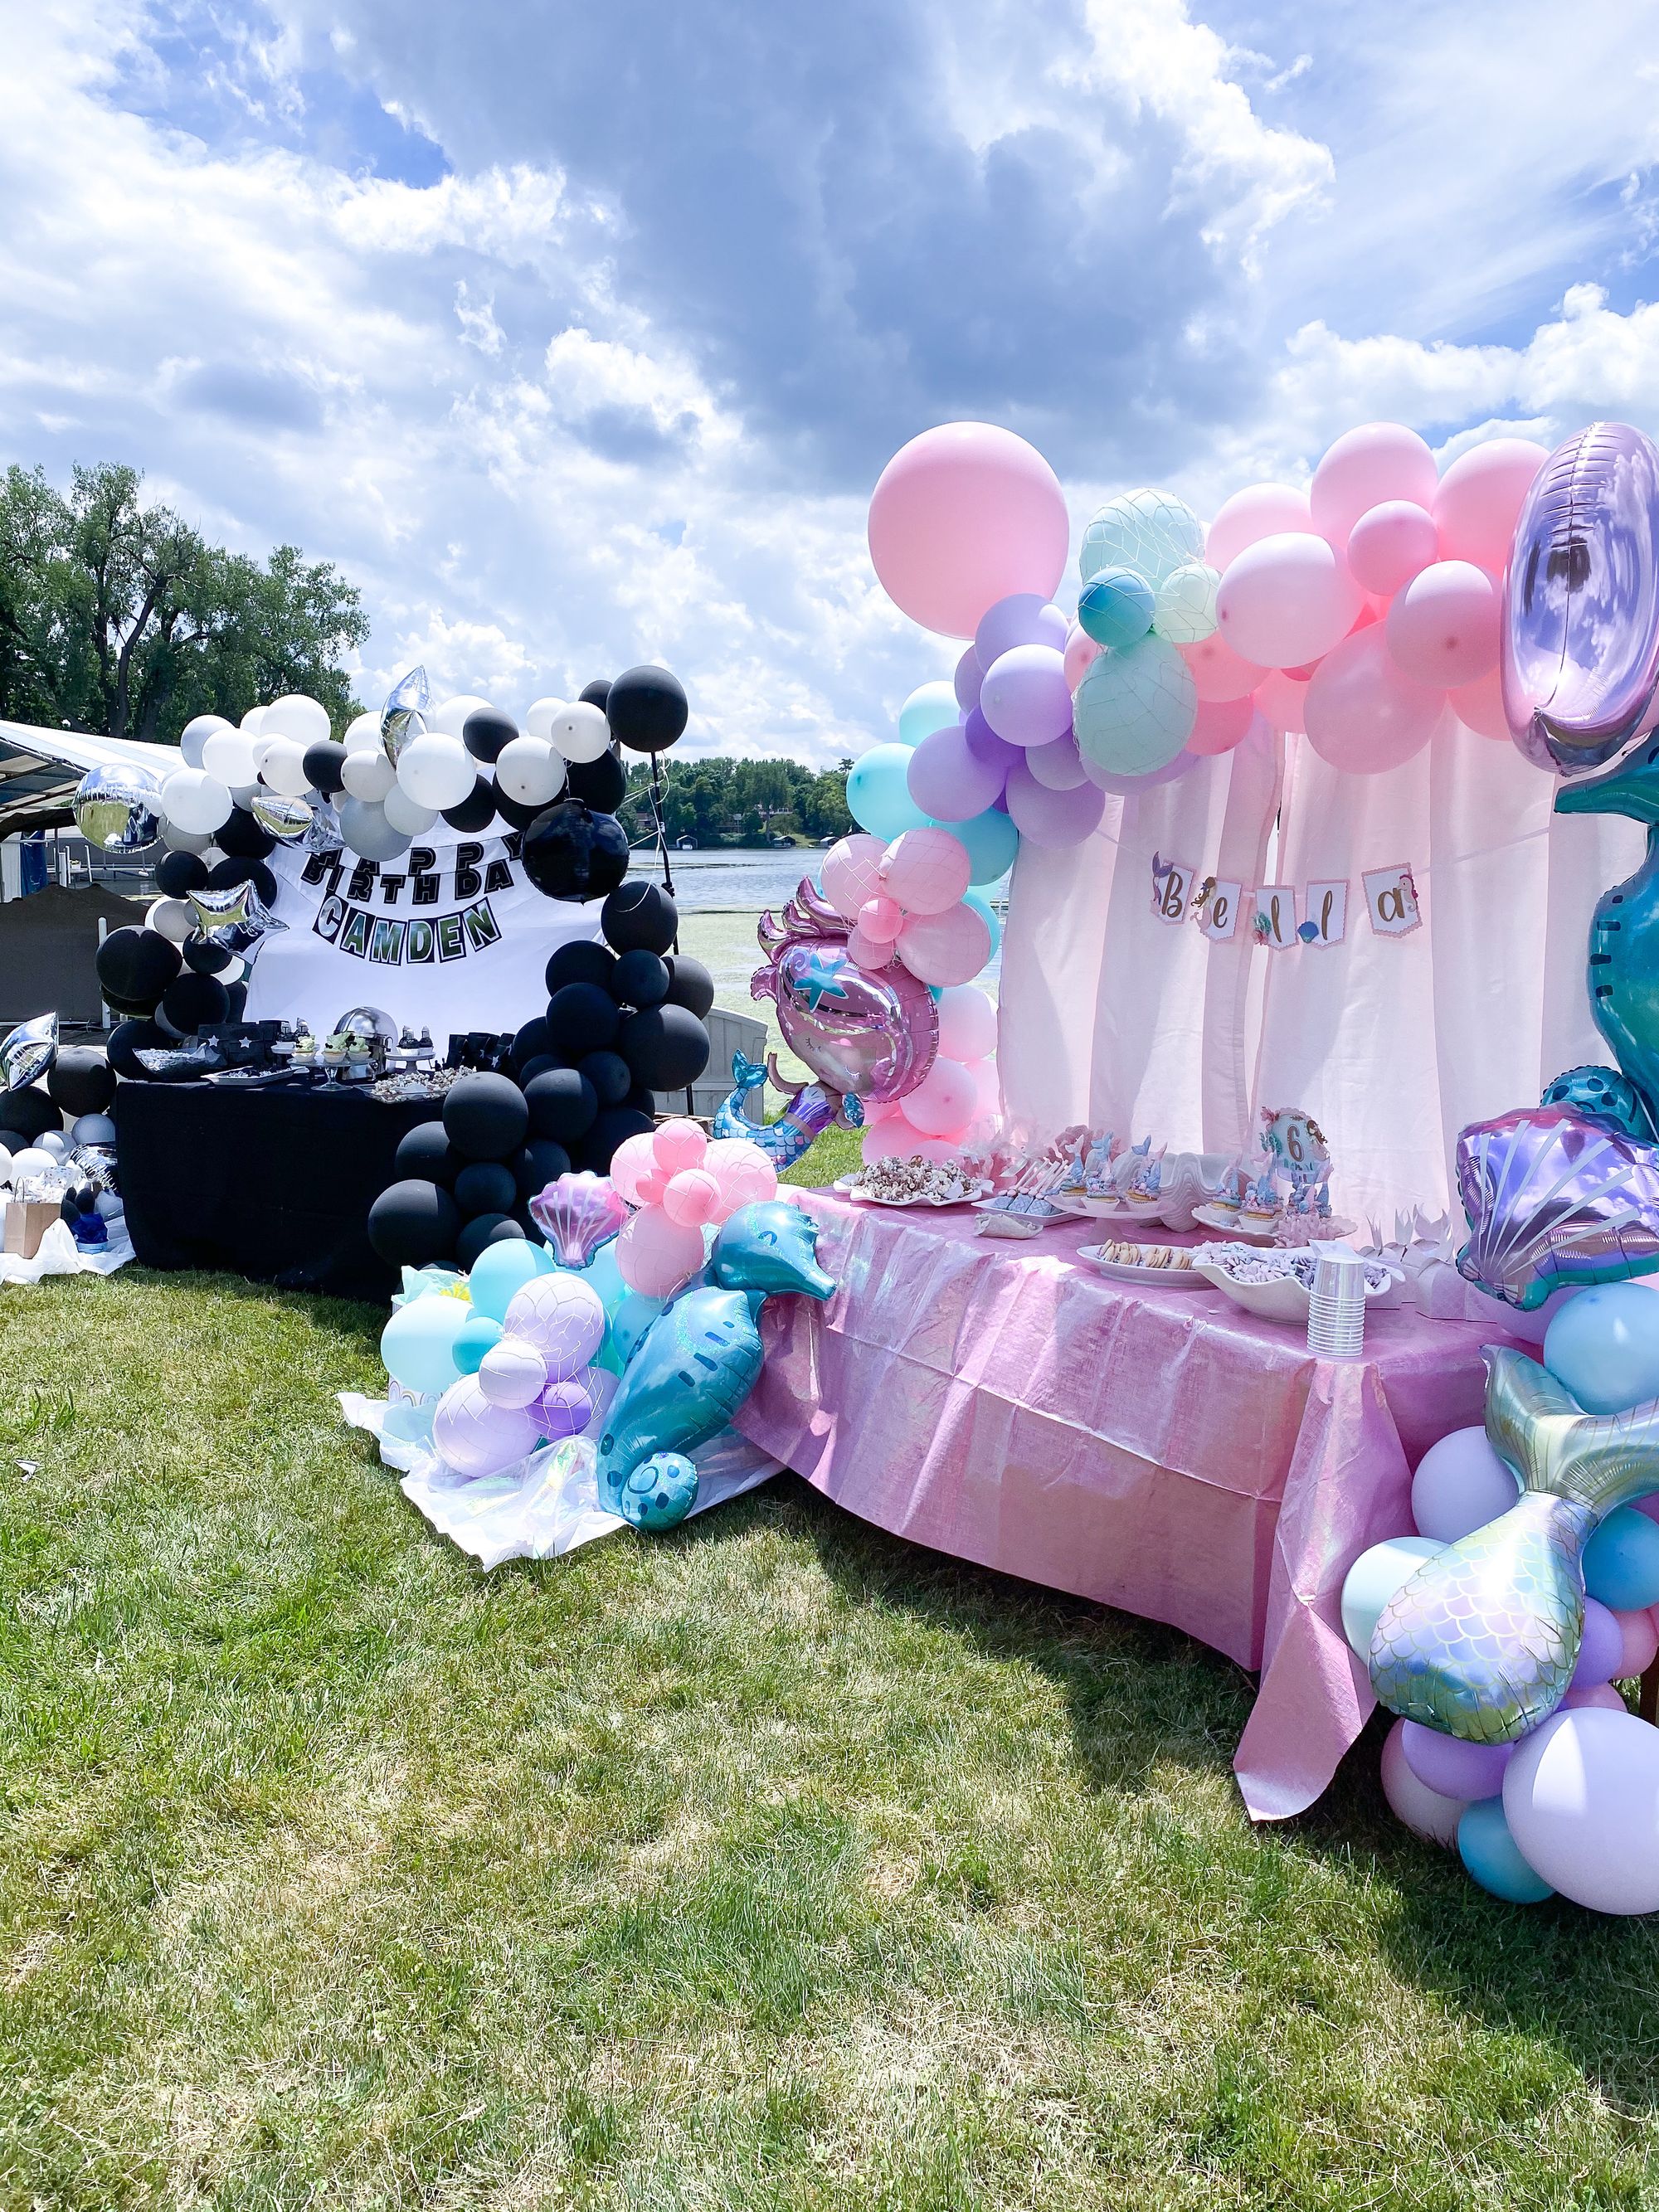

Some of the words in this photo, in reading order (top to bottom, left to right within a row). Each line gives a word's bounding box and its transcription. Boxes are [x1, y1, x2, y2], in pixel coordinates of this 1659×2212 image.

[300, 853, 514, 905] BIRTHDA
[316, 895, 500, 965] CAMDEN
[1287, 1124, 1305, 1162] 6
